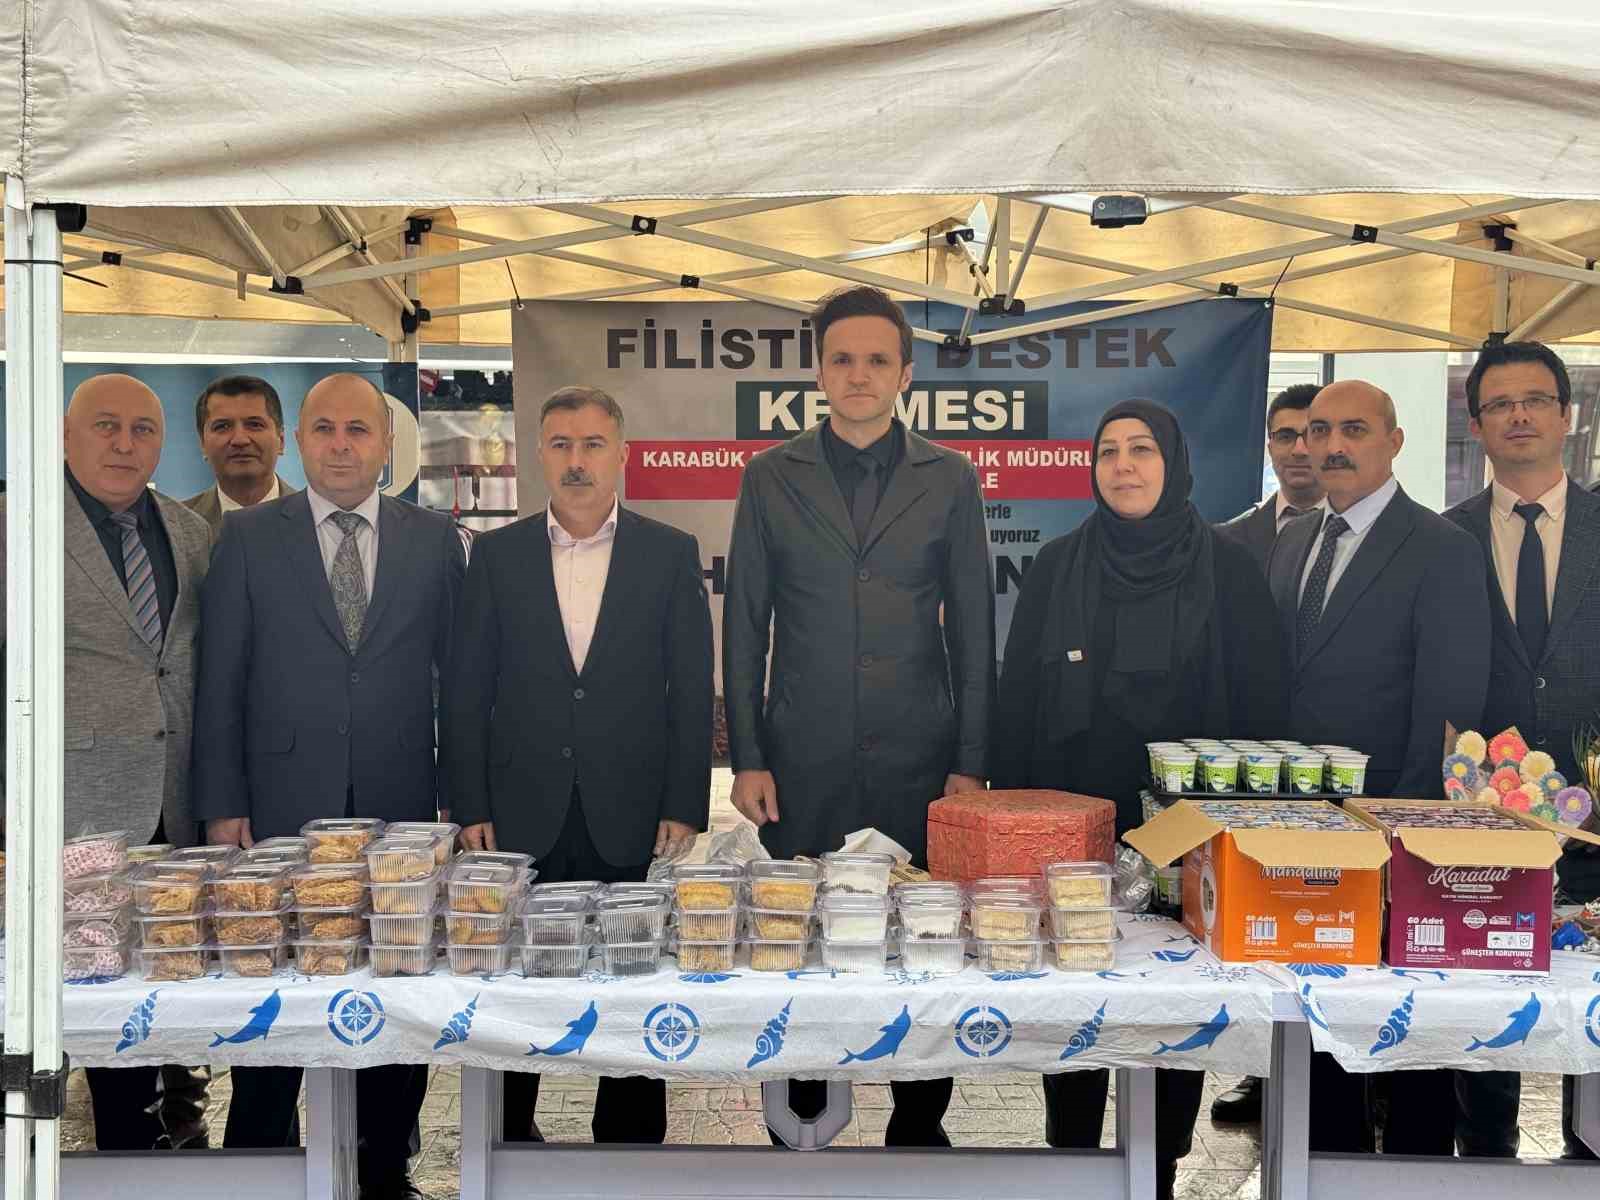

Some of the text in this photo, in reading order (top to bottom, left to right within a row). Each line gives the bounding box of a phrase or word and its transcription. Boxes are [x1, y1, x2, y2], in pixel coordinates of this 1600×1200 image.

[607, 318, 813, 369] FİLİSTİ
[643, 448, 745, 468] KARABÜK
[1007, 447, 1093, 467] MÜDÜRL
[1427, 866, 1513, 888] Karadut
[1421, 916, 1445, 925] Adet
[1461, 948, 1495, 958] GÜNEŞTEN
[1495, 949, 1534, 958] KORUYUNUZ
